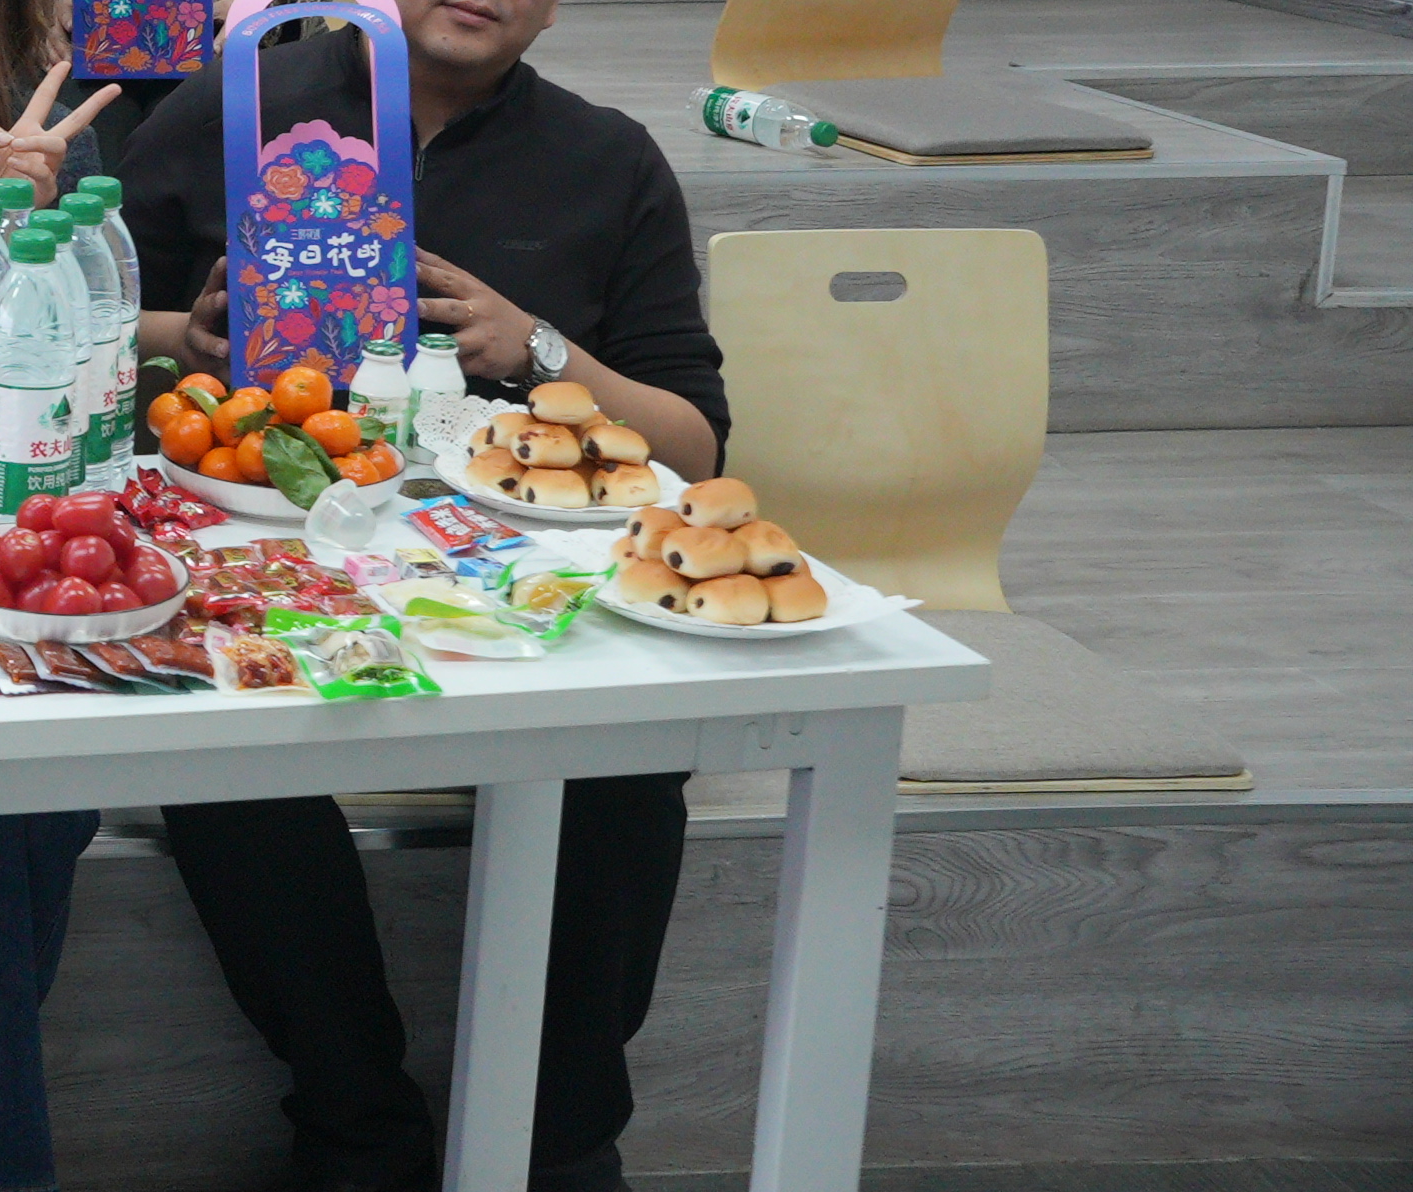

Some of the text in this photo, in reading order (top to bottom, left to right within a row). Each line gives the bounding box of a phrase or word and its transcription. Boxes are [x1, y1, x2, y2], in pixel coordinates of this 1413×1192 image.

[261, 232, 383, 281] 每日花时
[29, 436, 73, 459] 农夫山
